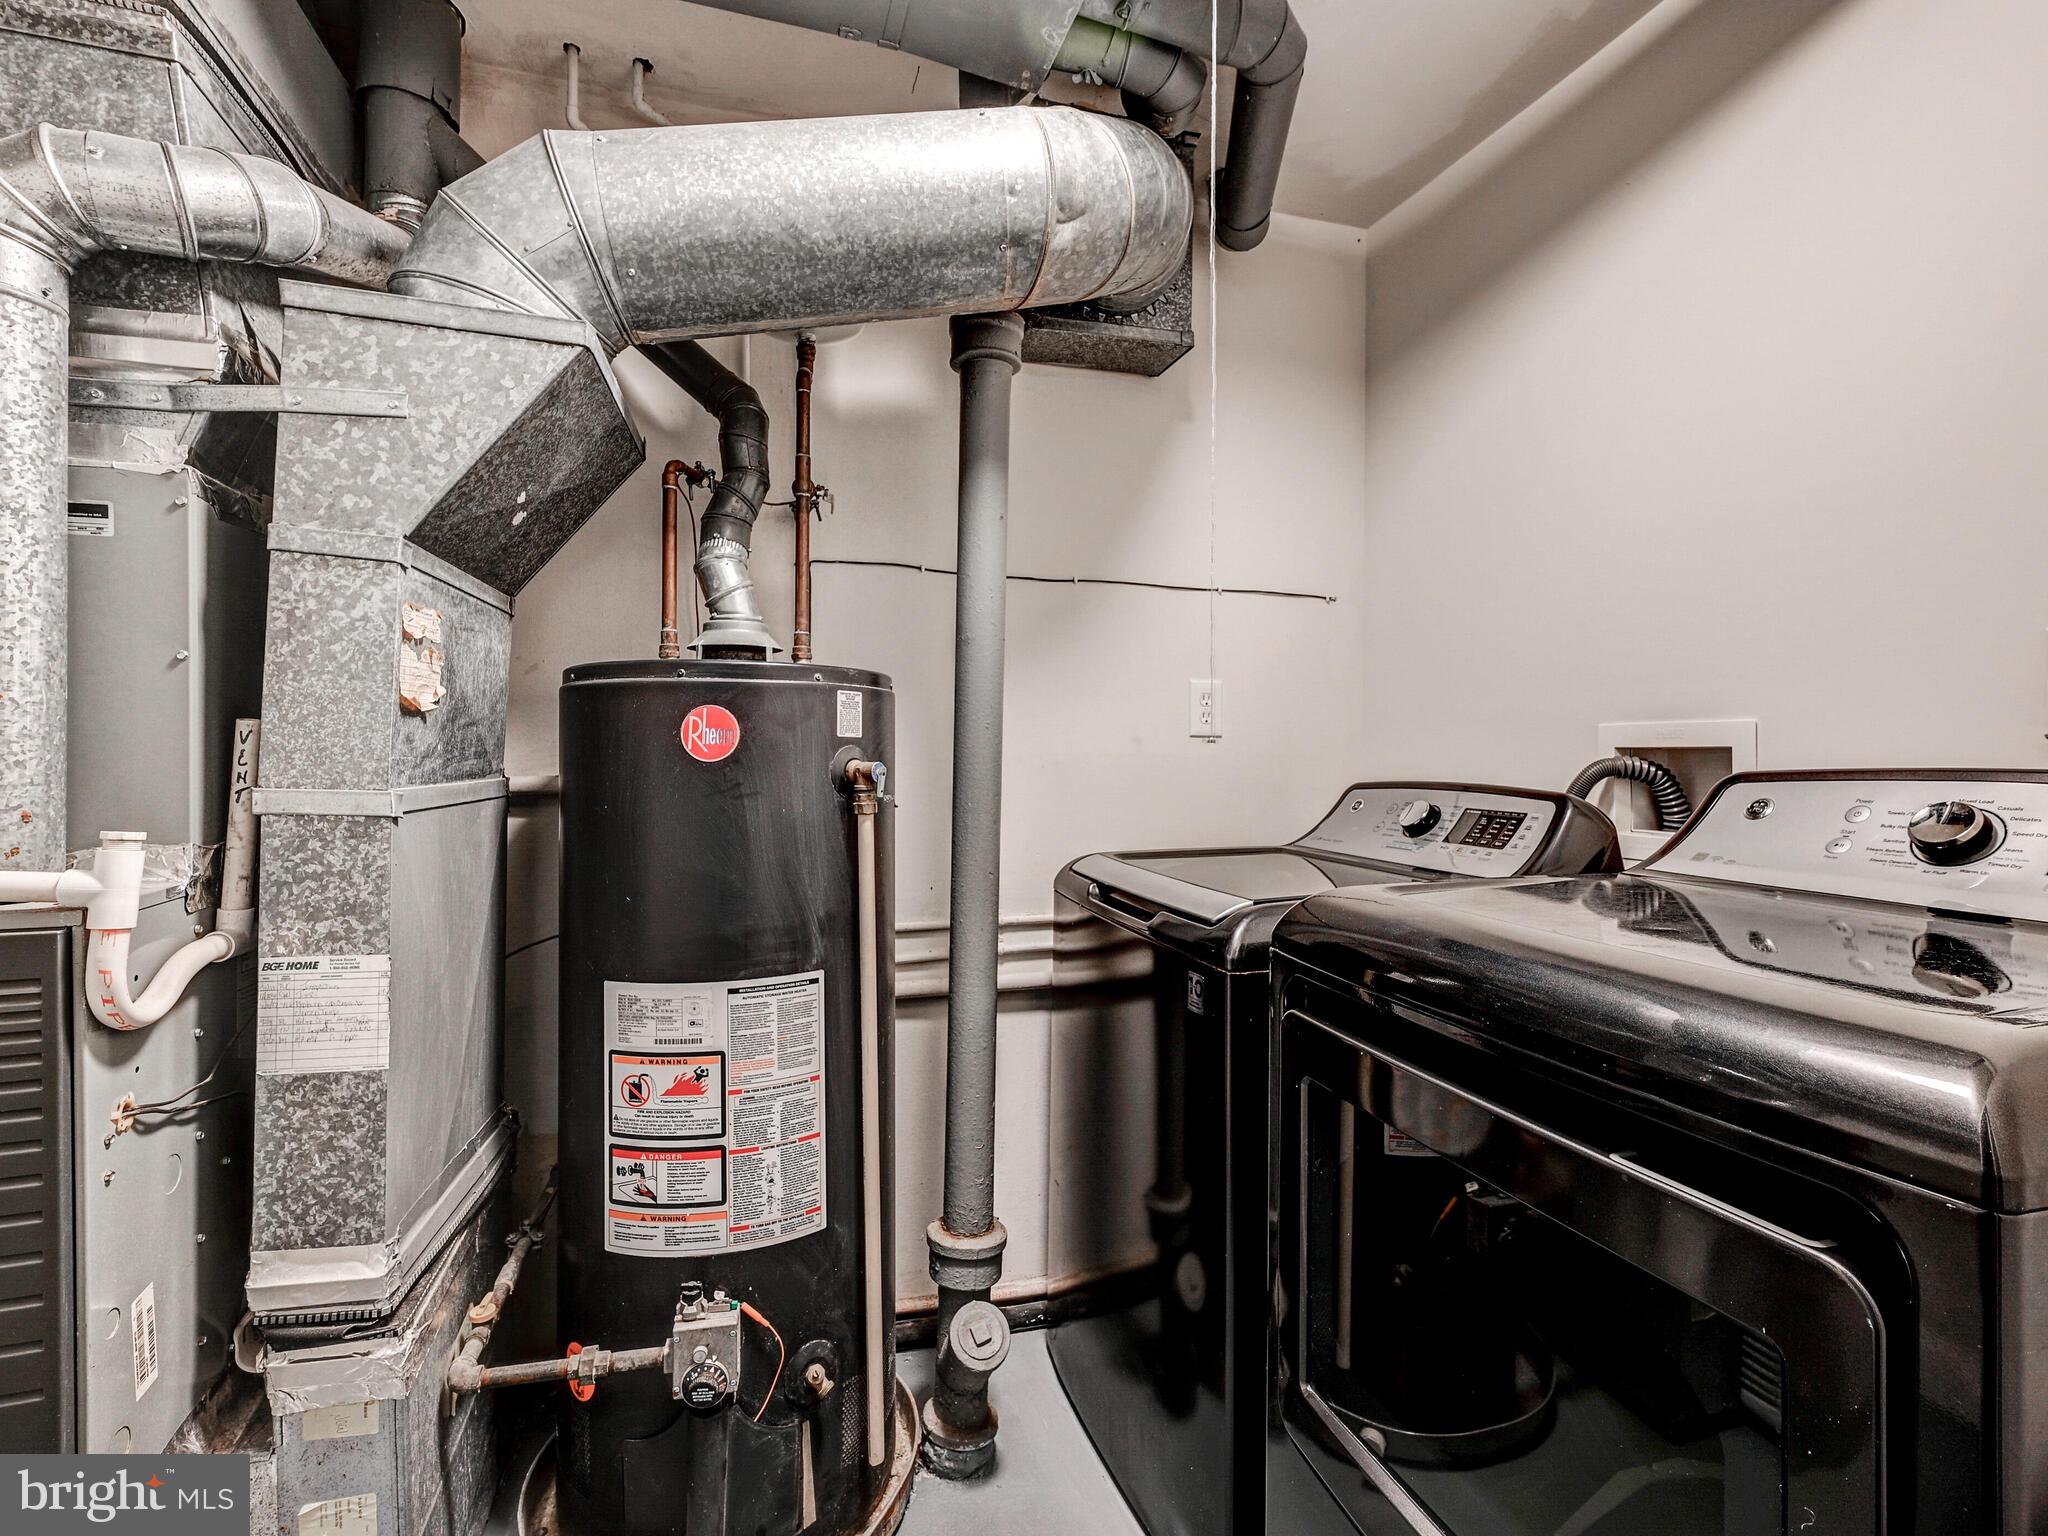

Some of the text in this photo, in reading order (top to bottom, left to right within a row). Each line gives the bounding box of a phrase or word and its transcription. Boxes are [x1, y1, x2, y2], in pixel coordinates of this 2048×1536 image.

[687, 707, 736, 752] Rheem
[234, 729, 253, 804] VENT
[262, 961, 320, 972] BGE HOME
